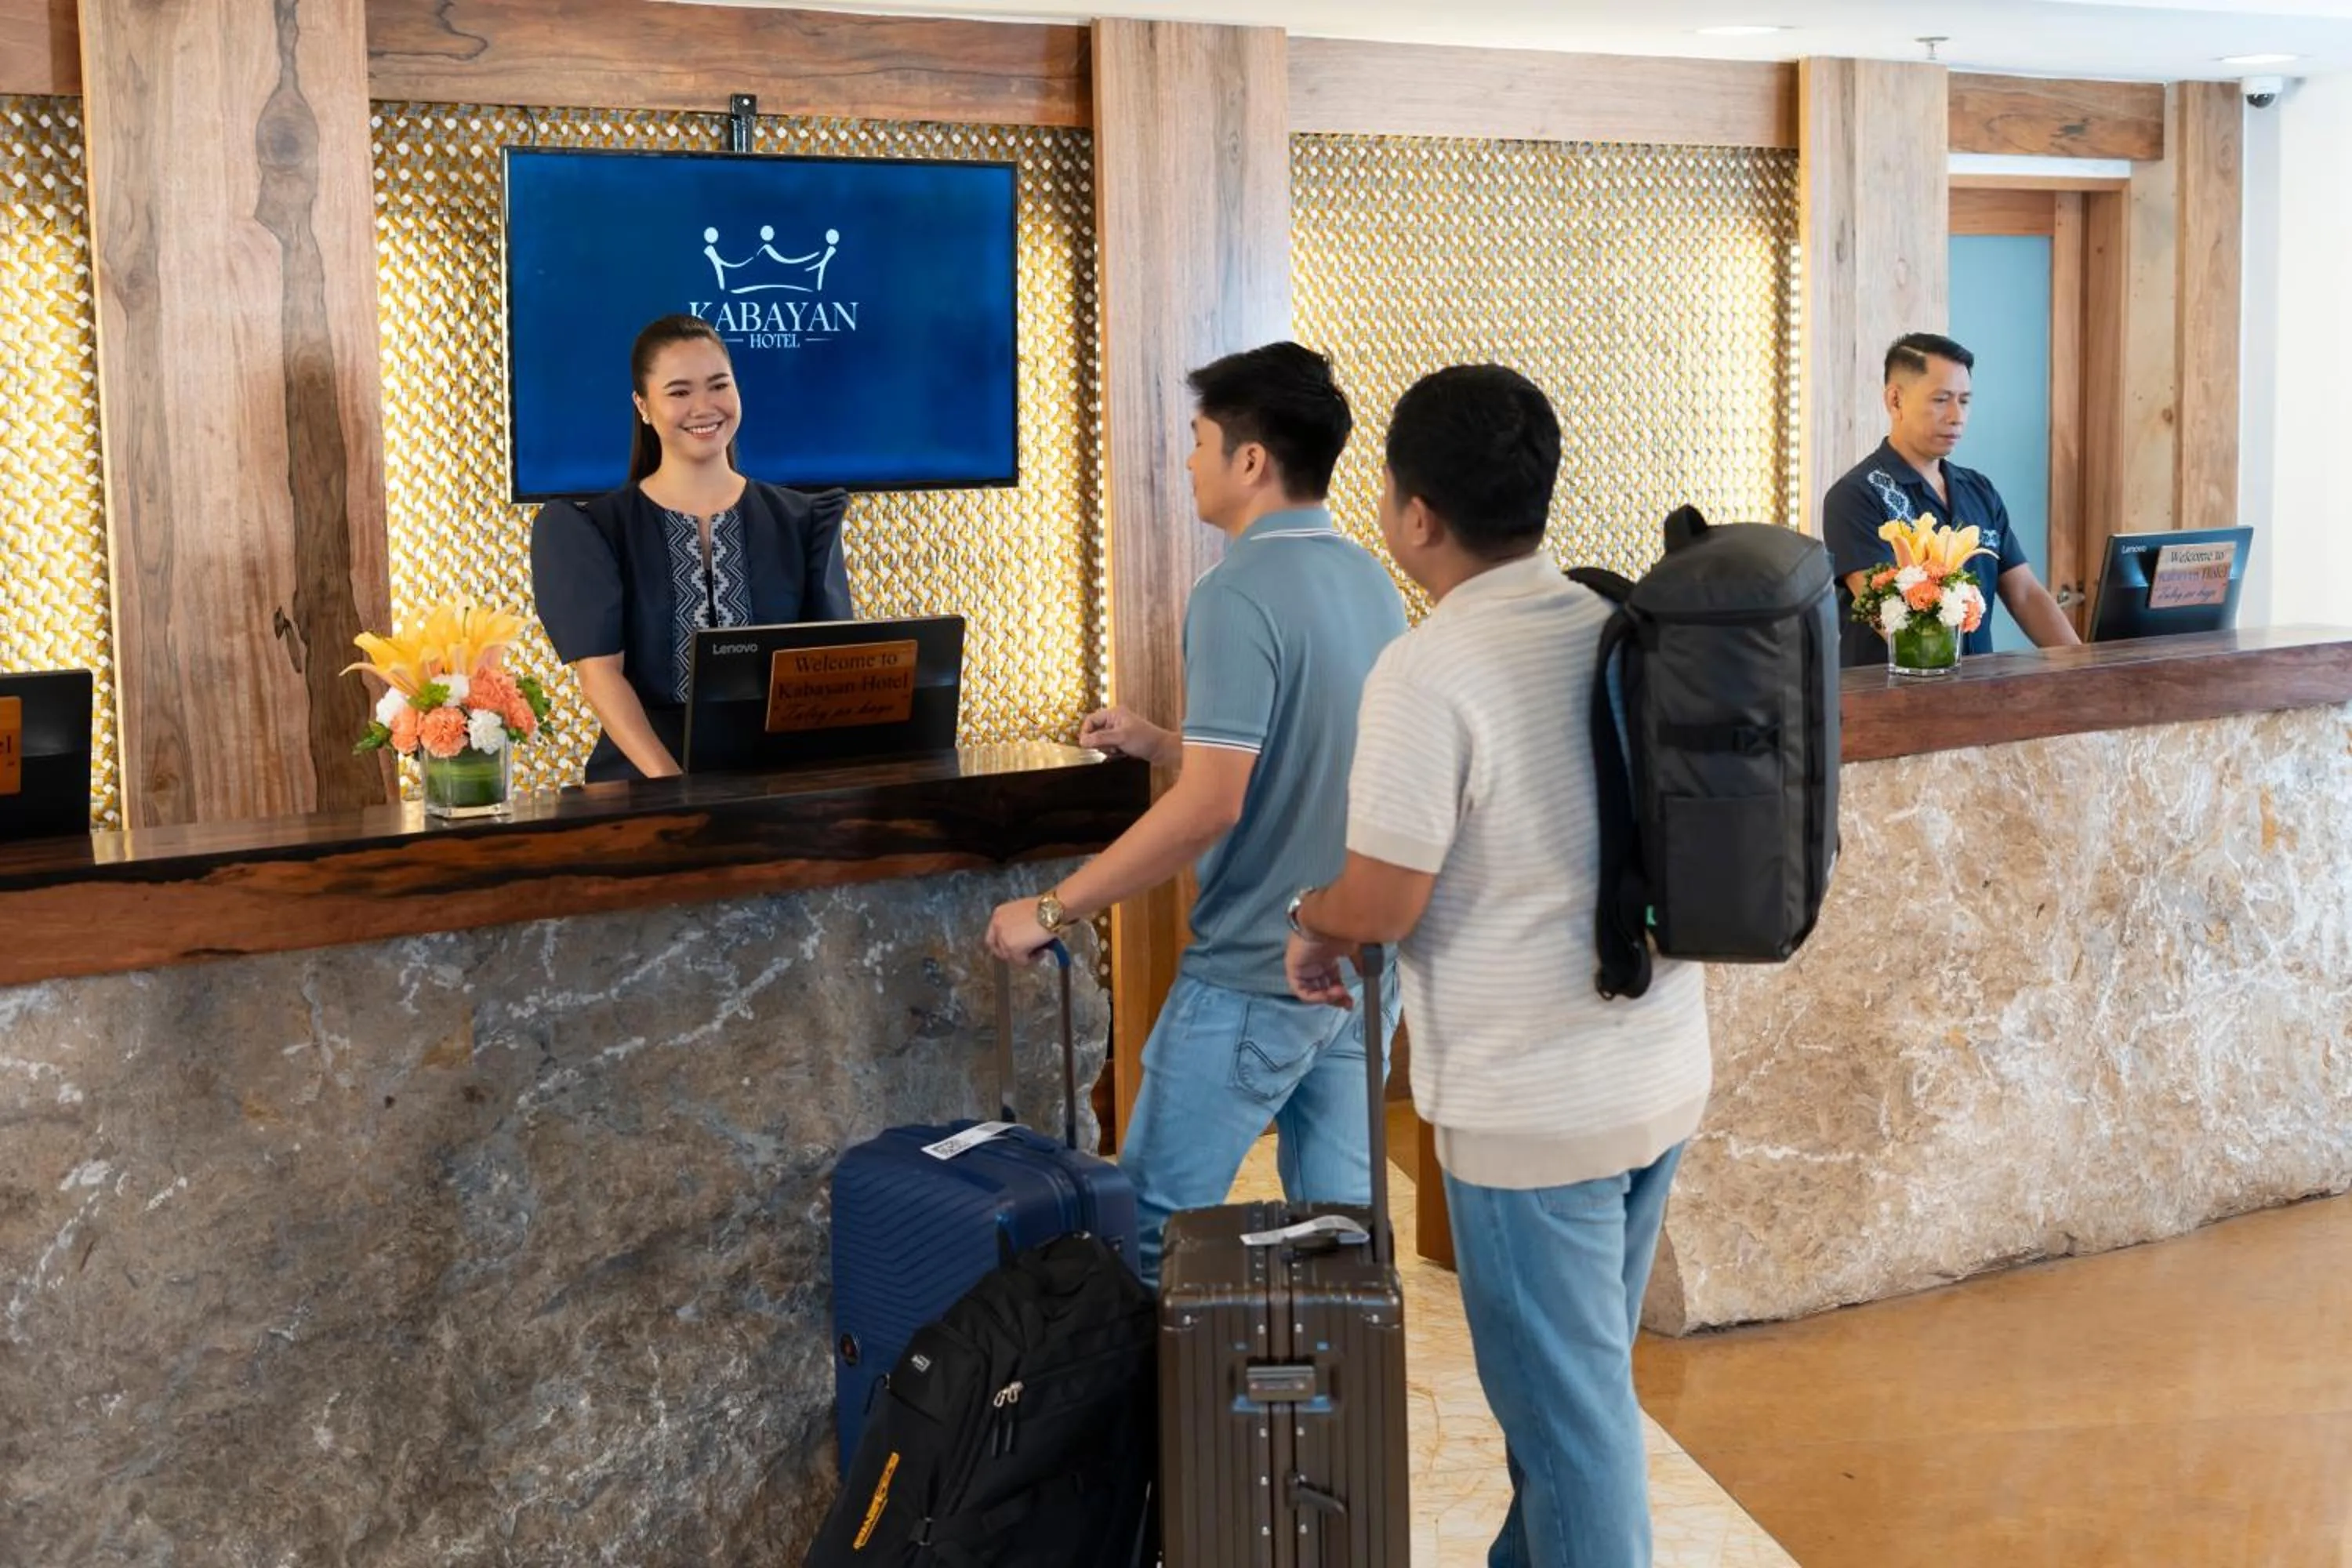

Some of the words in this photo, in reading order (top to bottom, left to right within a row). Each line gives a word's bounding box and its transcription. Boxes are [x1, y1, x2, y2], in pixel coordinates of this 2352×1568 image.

[750, 333, 800, 349] HOTEL
[2170, 551, 2213, 563] Welcome
[712, 643, 758, 655] Lenovo
[795, 654, 877, 673] Welcome
[882, 652, 898, 666] to
[779, 679, 855, 700] Kabayan
[862, 670, 909, 692] Hotel
